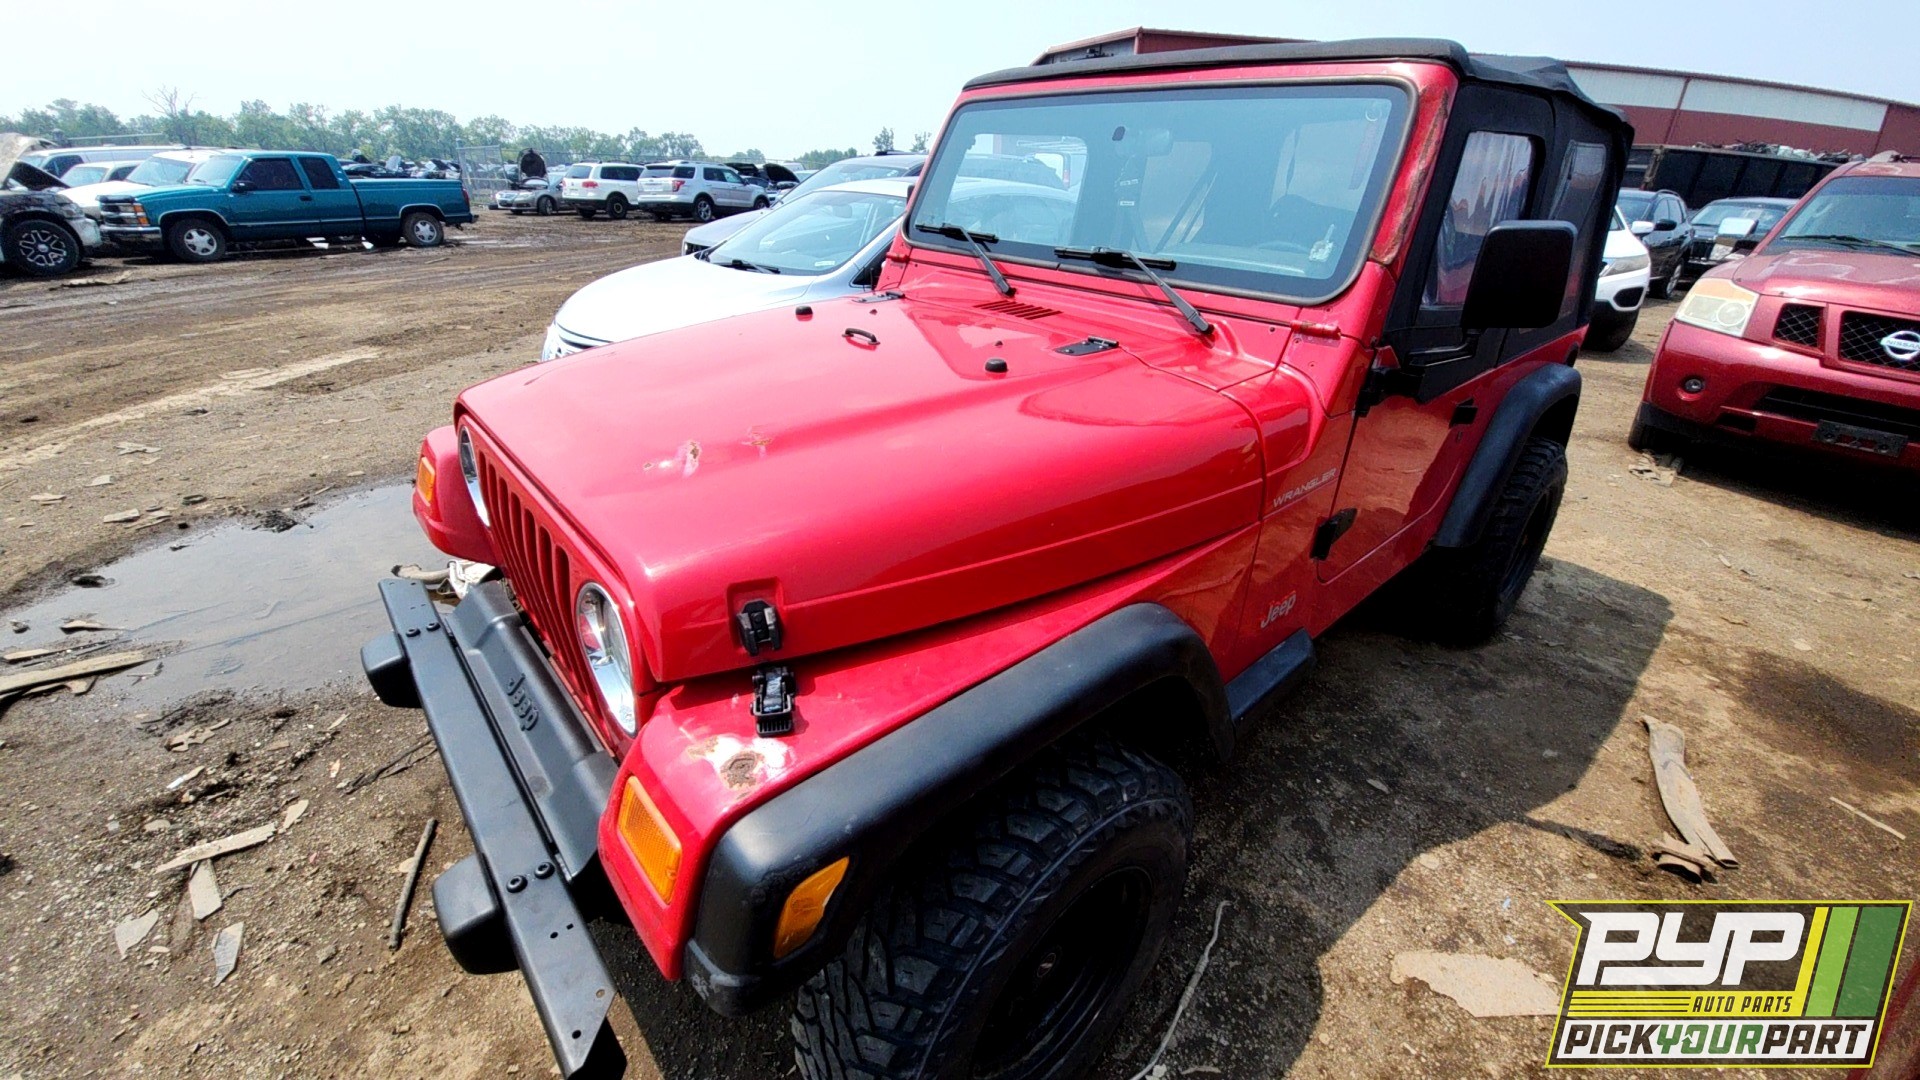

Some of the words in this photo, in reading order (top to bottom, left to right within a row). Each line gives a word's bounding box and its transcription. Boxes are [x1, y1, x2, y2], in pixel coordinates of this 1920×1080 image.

[1273, 468, 1337, 507] WRANGLER
[1260, 591, 1296, 629] Jeep
[507, 673, 539, 731] Jeep
